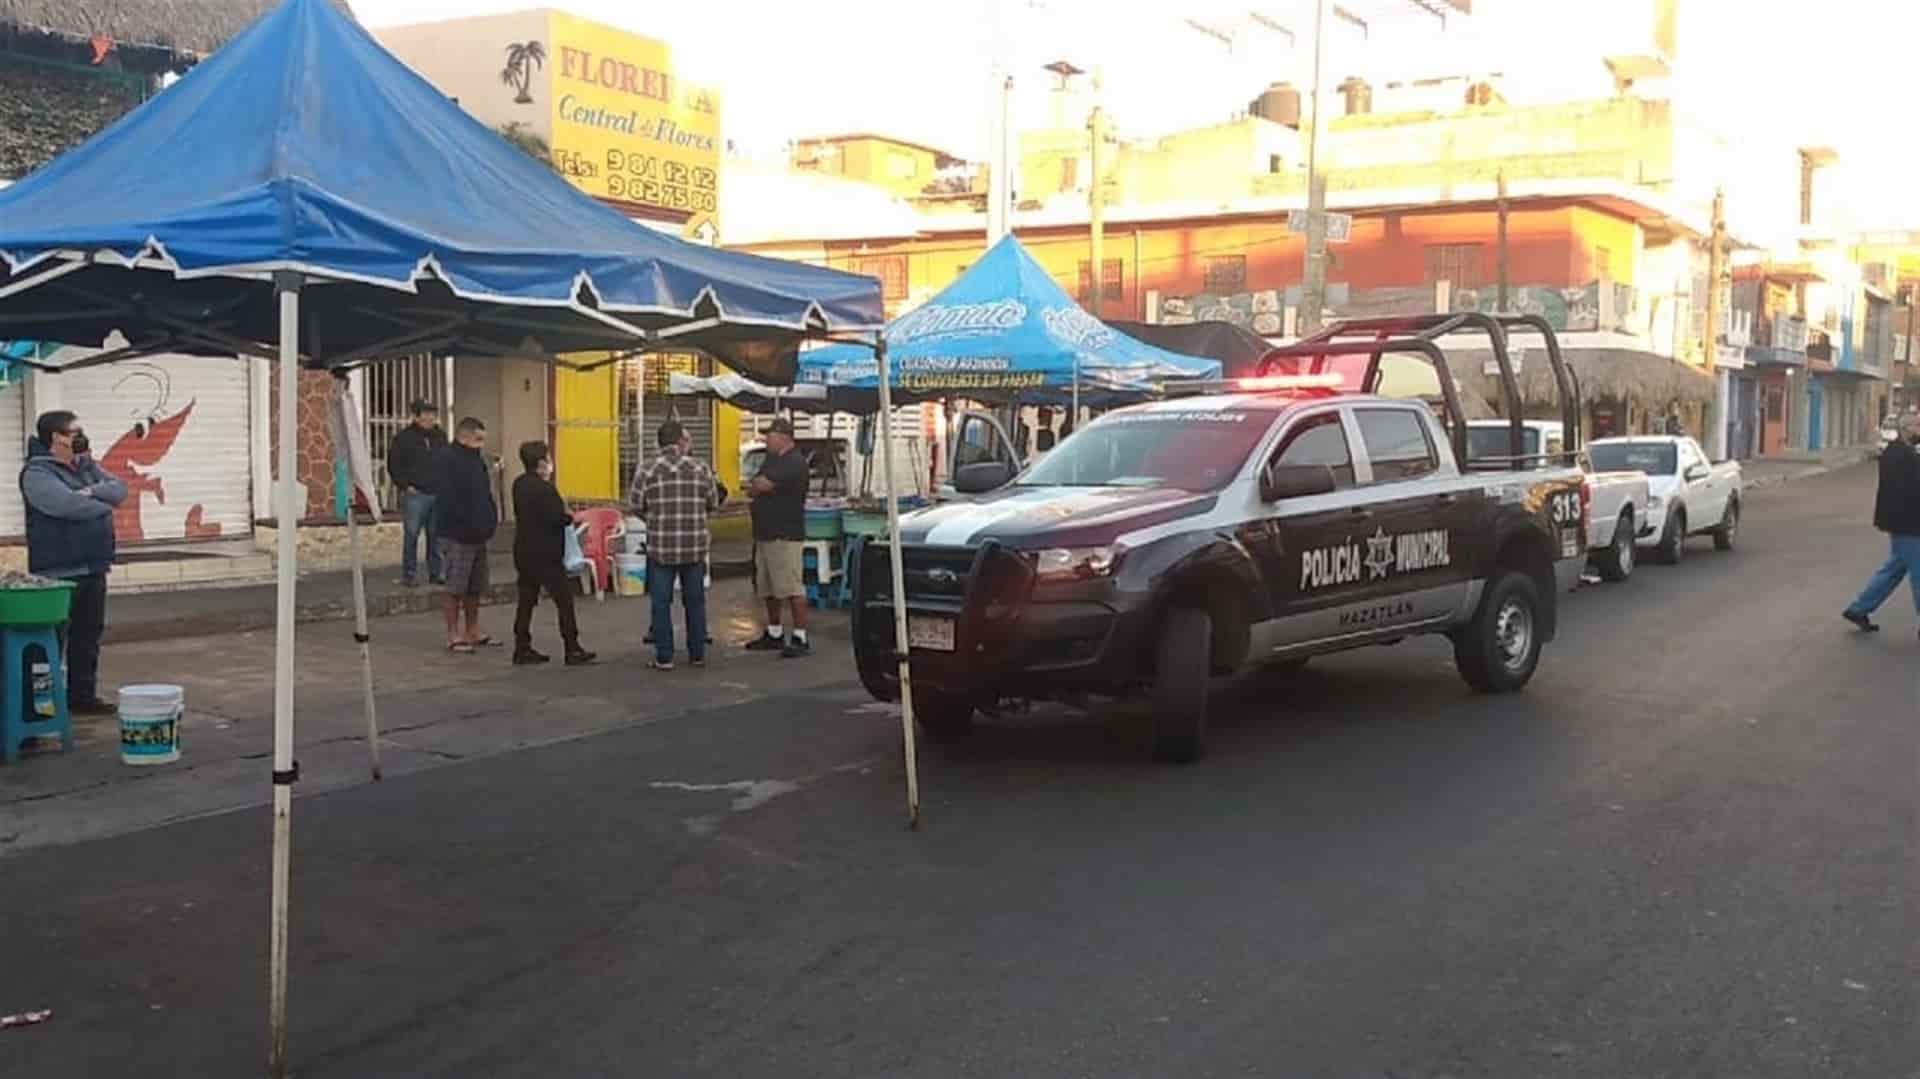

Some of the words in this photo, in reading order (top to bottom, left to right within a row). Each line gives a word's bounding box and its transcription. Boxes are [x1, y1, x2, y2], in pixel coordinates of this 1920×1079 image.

[559, 93, 638, 135] Central
[655, 118, 713, 151] Flores
[607, 149, 625, 171] 9
[628, 154, 656, 179] 81
[663, 161, 689, 186] 12
[692, 167, 718, 191] 12
[608, 174, 626, 197] 9
[628, 178, 659, 204] 82
[661, 184, 689, 208] 75
[1552, 492, 1581, 522] 313
[1300, 535, 1361, 590] POLICÍA
[1396, 528, 1451, 572] MUNICIPAL
